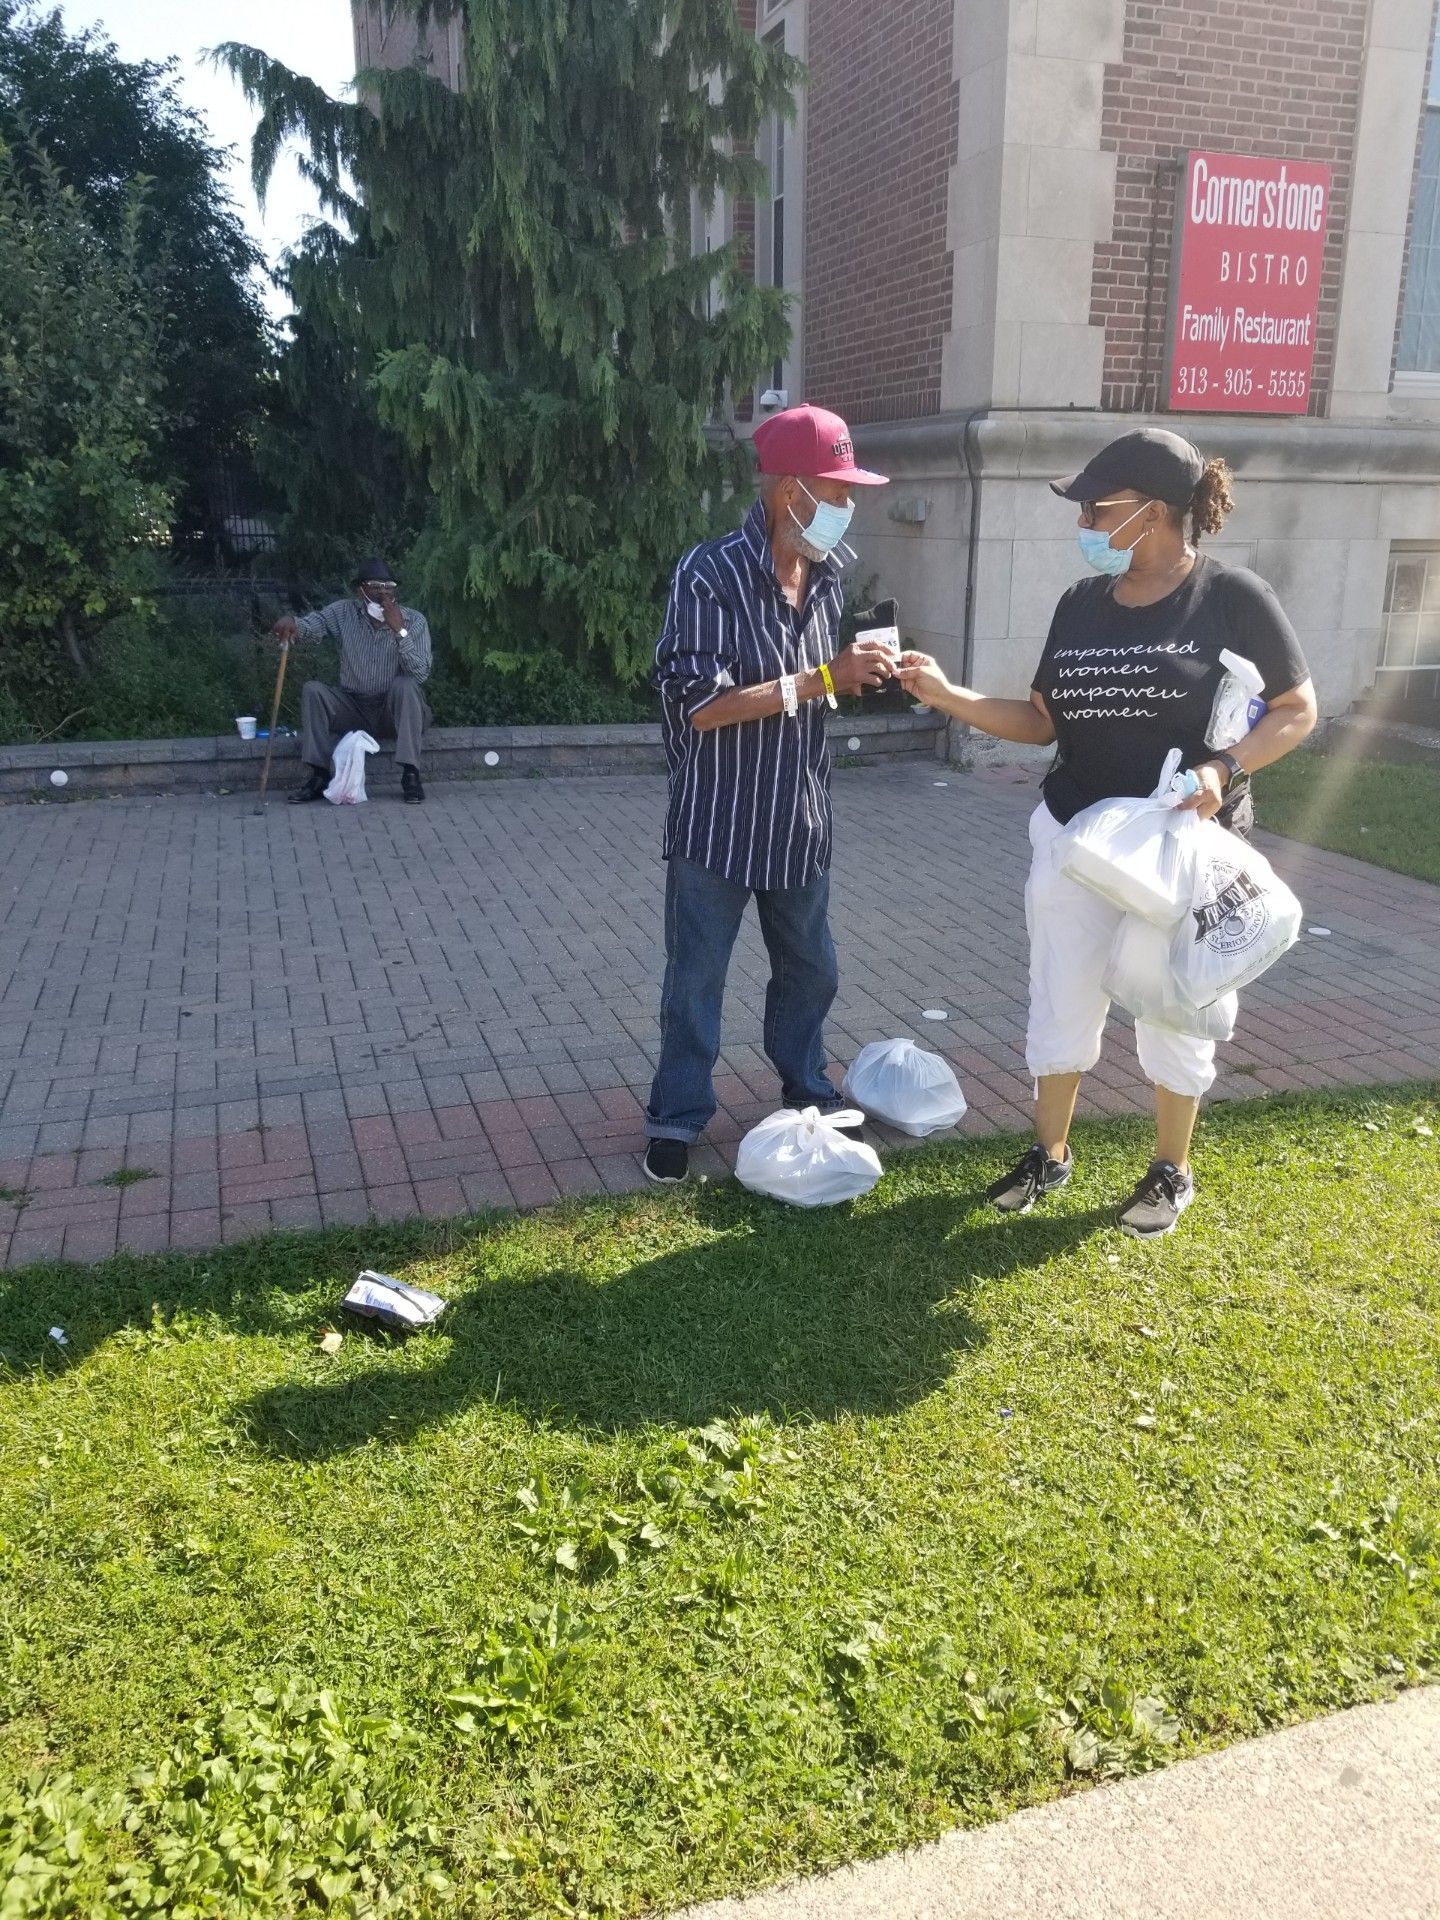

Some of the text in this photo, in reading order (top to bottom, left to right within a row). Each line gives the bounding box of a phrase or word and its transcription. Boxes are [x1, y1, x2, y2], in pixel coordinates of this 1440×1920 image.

[1190, 158, 1324, 232] Cornerstone
[1220, 251, 1308, 286] BISTRO
[1181, 304, 1311, 352] Family Restaurant
[1059, 663, 1159, 679] women
[1062, 707, 1158, 720] women
